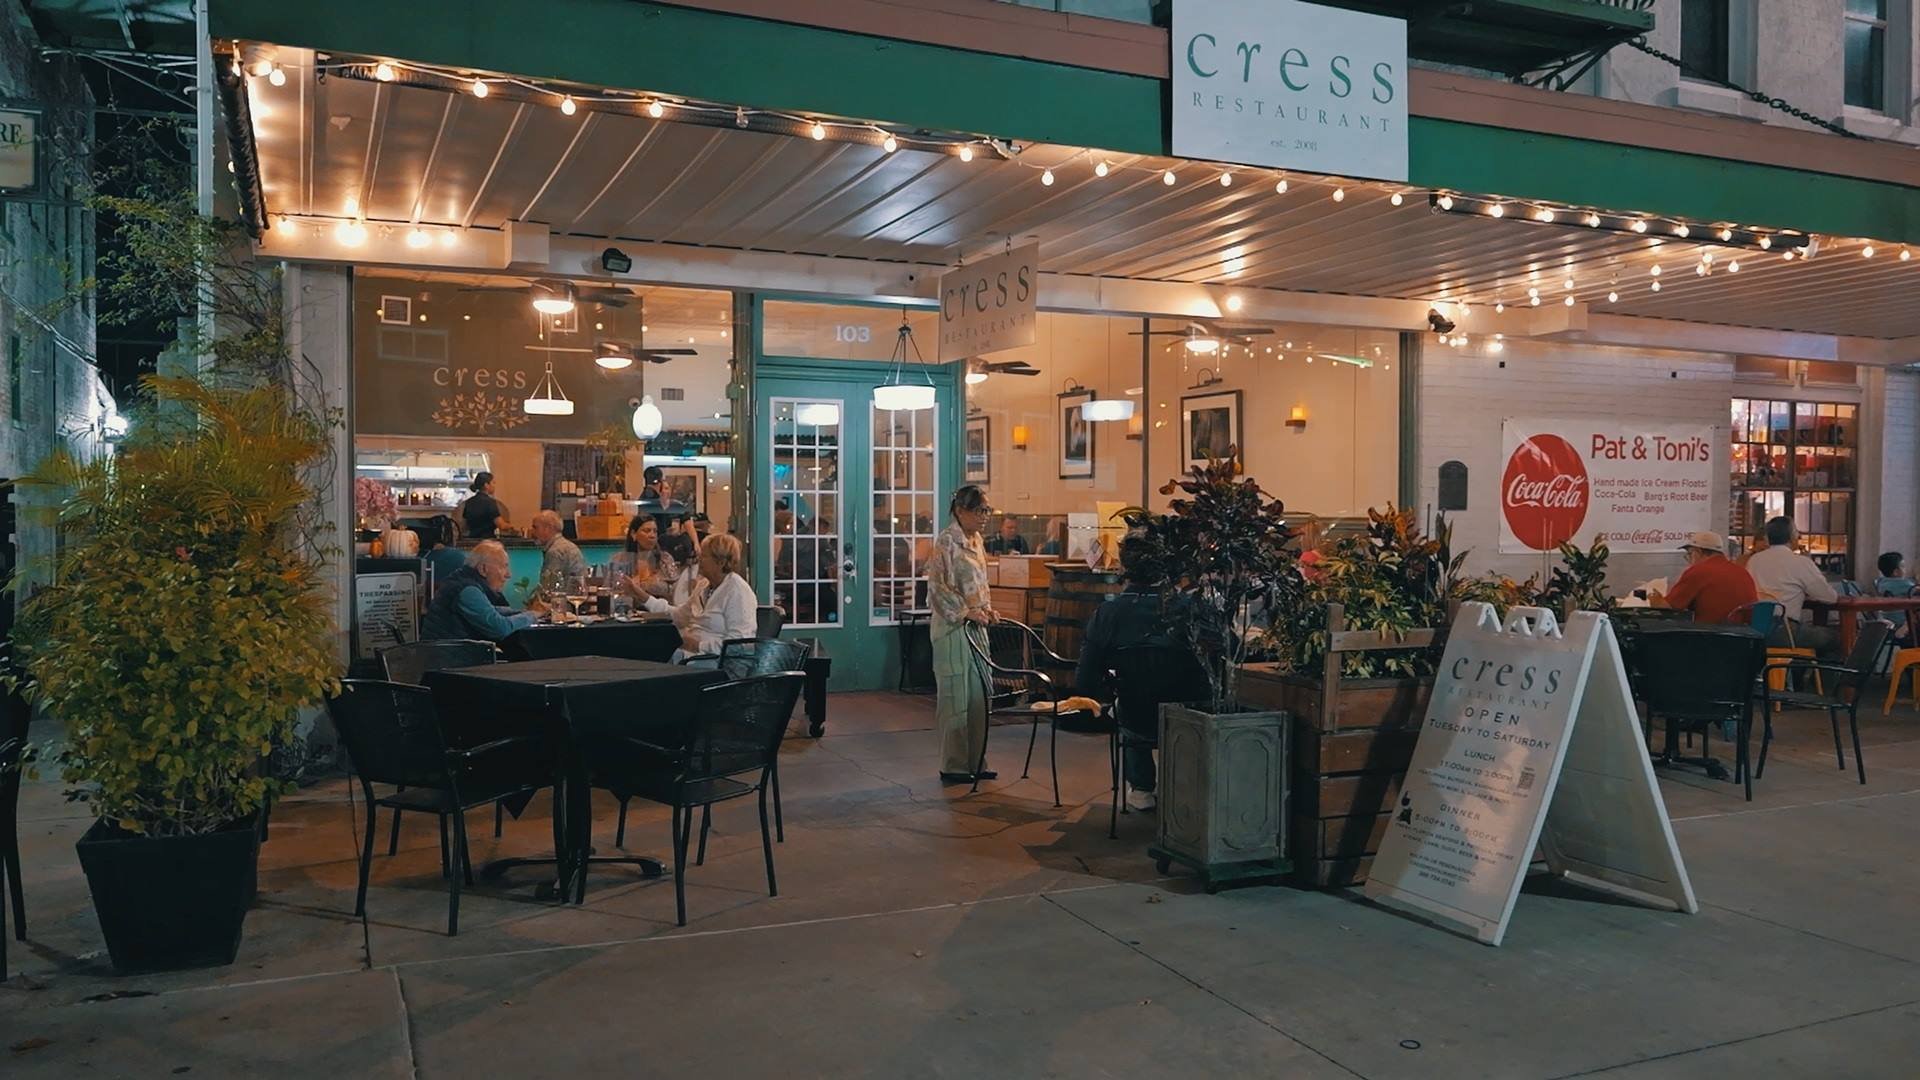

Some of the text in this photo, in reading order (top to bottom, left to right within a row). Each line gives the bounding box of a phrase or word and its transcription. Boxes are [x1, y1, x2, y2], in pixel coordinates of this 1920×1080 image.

[1187, 33, 1394, 104] cress
[1193, 91, 1390, 132] RESTAURANT
[944, 265, 1029, 322] cress
[834, 325, 870, 342] 103
[945, 313, 1027, 344] RESTAURANT
[433, 367, 527, 389] cress
[1591, 433, 1710, 462] Pat & Toni's
[1507, 473, 1585, 508] Coca-Cola
[1593, 478, 1615, 487] Hand
[1616, 478, 1640, 487] made
[1655, 478, 1680, 488] Cream
[1594, 488, 1636, 498] Coca-Cola
[1670, 491, 1689, 501] Root
[1690, 492, 1709, 502] Beer
[1611, 503, 1665, 514] Fanta Orange
[1610, 532, 1631, 541] COLD
[1663, 532, 1683, 541] SOLD
[1452, 656, 1561, 694] cress
[1448, 685, 1550, 711] RESTAURANT
[1464, 706, 1521, 726] OPEN
[1429, 718, 1552, 750] TUESDAY TO SATURDAY
[1464, 749, 1496, 762] LUNCH
[1440, 803, 1481, 821] DINNER
